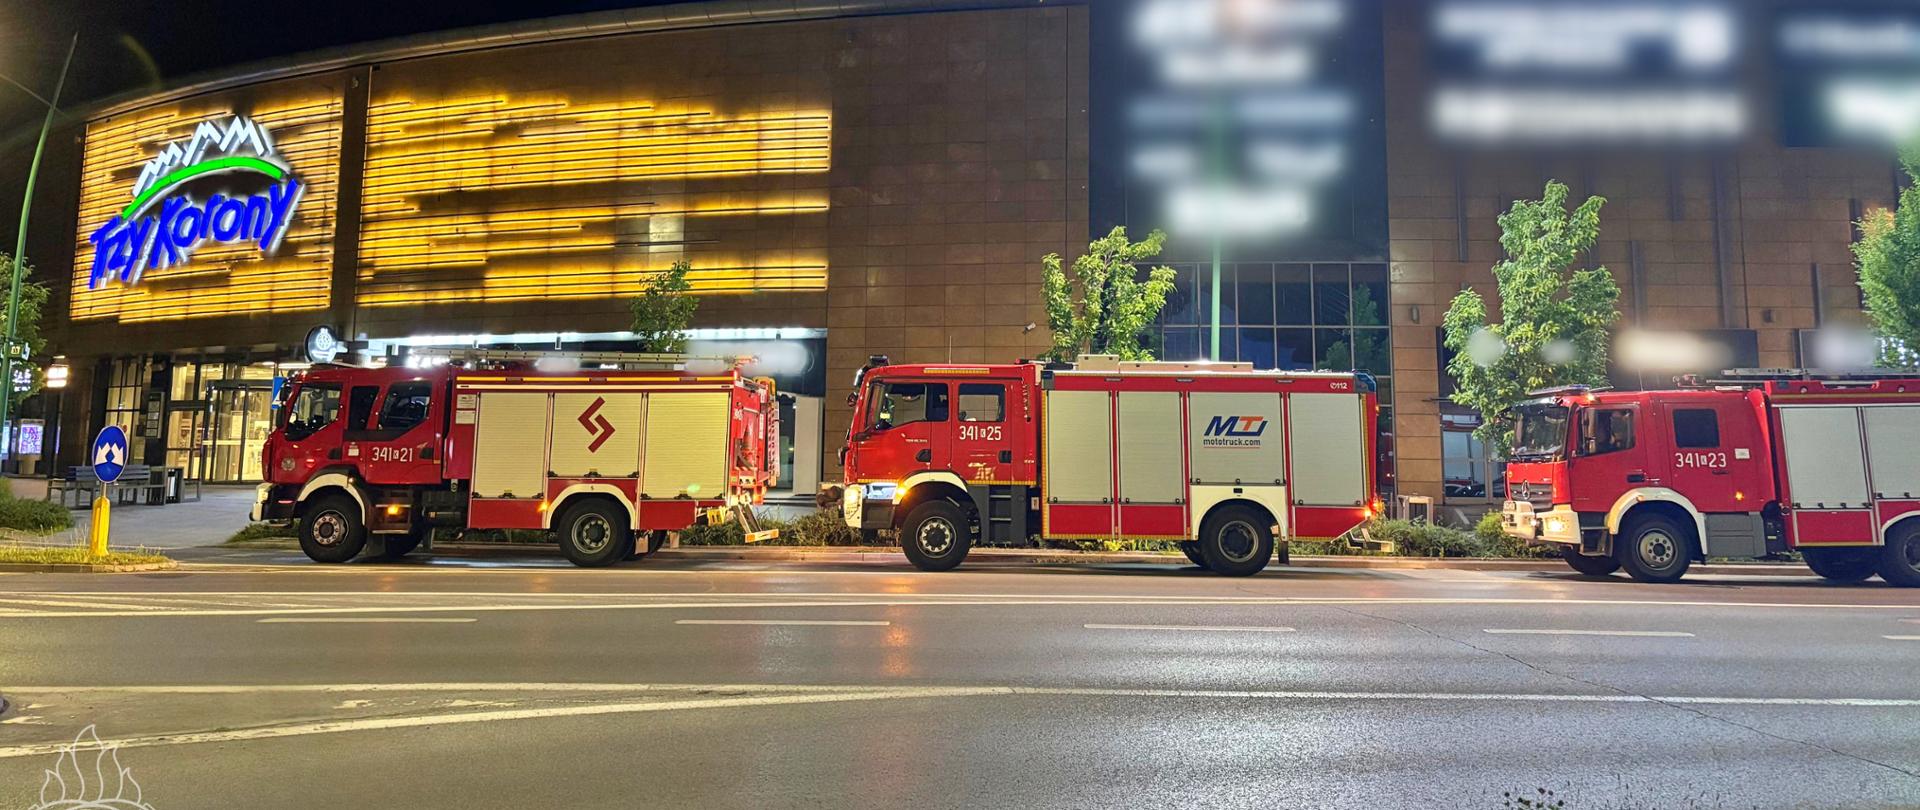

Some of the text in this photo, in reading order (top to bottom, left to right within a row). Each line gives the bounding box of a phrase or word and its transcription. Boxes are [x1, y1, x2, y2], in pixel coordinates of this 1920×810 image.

[90, 179, 299, 289] Trzy Korony
[1203, 438, 1261, 446] mototruck.com
